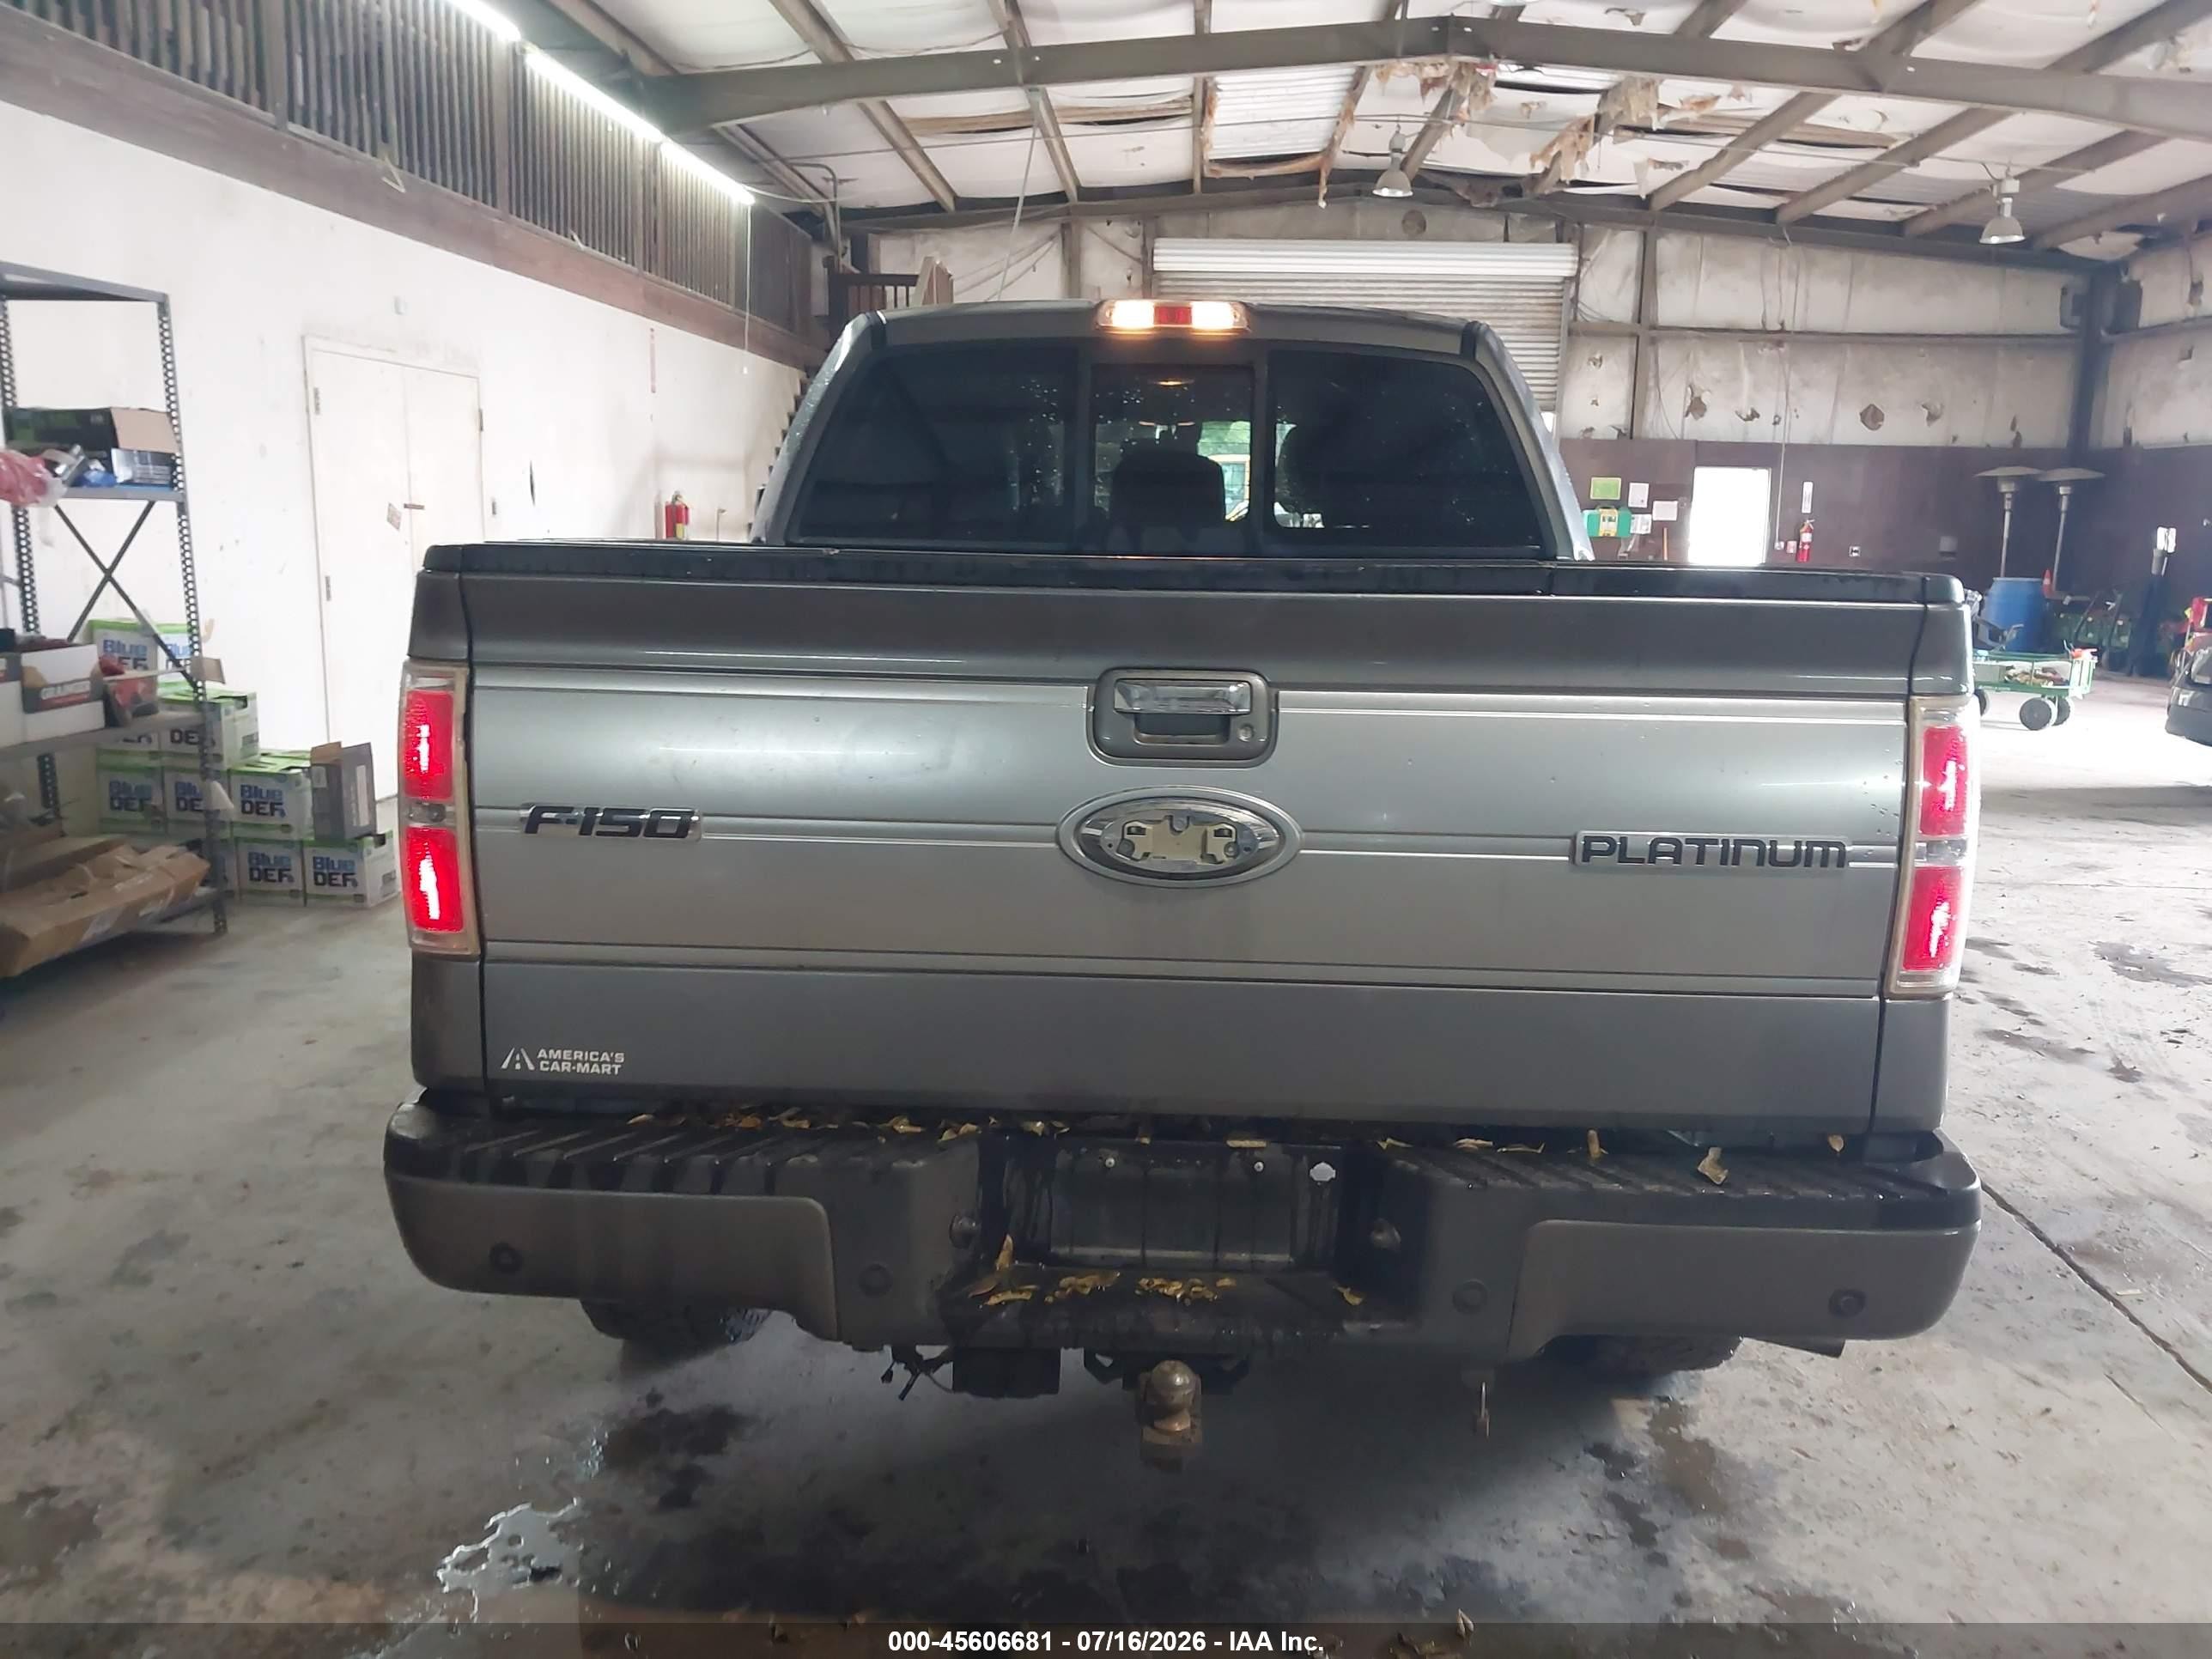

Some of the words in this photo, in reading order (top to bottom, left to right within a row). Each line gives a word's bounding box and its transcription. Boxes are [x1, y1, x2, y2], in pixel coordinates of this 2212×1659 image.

[103, 639, 148, 658] Blue
[240, 784, 283, 801] Blue
[176, 798, 205, 812] DE
[240, 800, 286, 817] DEF
[525, 805, 694, 839] F-150
[248, 851, 293, 868] Blue
[1581, 836, 1846, 869] PLATINUM
[313, 856, 356, 872] Blue
[248, 867, 294, 884] DEF
[313, 871, 359, 888] DEF
[537, 1048, 625, 1064] AMERICA'S
